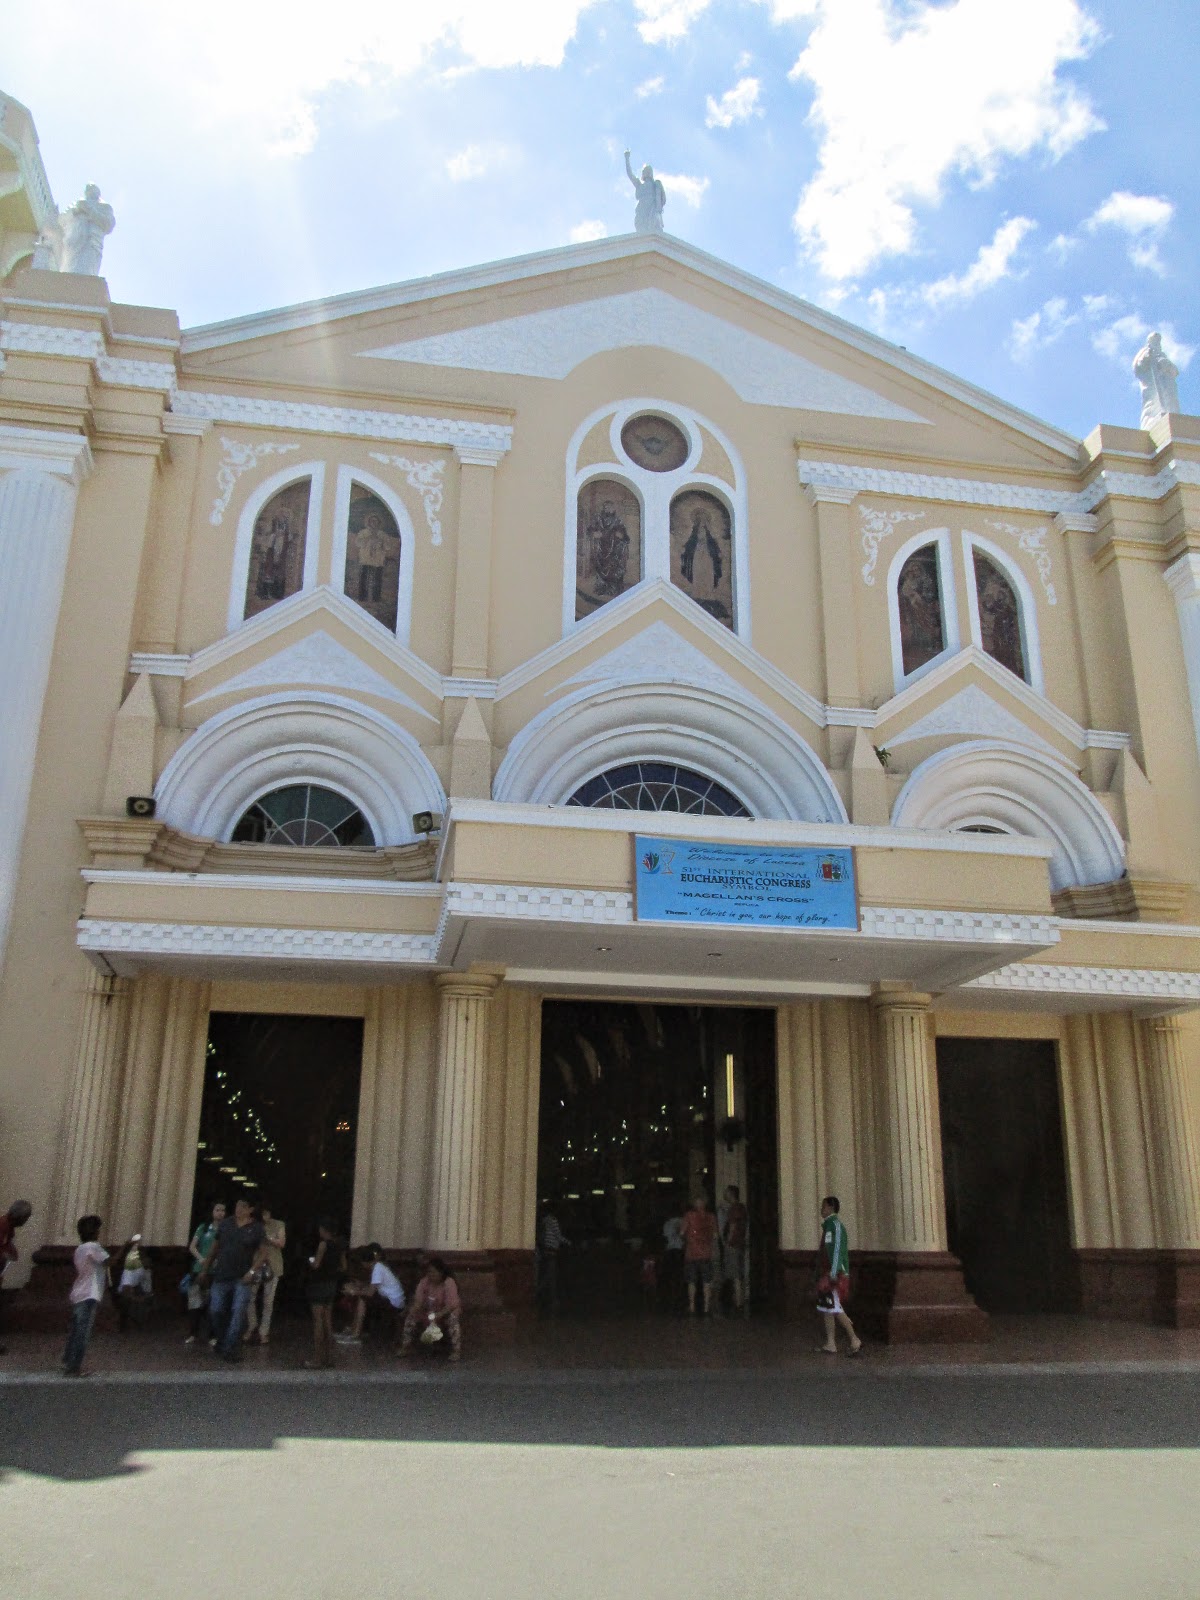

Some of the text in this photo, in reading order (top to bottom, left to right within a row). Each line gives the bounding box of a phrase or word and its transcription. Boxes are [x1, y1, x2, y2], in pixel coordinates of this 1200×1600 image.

[744, 857, 759, 865] of
[708, 868, 810, 879] INTERNATIONAL
[681, 873, 811, 888] EUCHARISTIC CONGRESS
[722, 884, 772, 892] SYMBOL
[775, 912, 792, 921] hope
